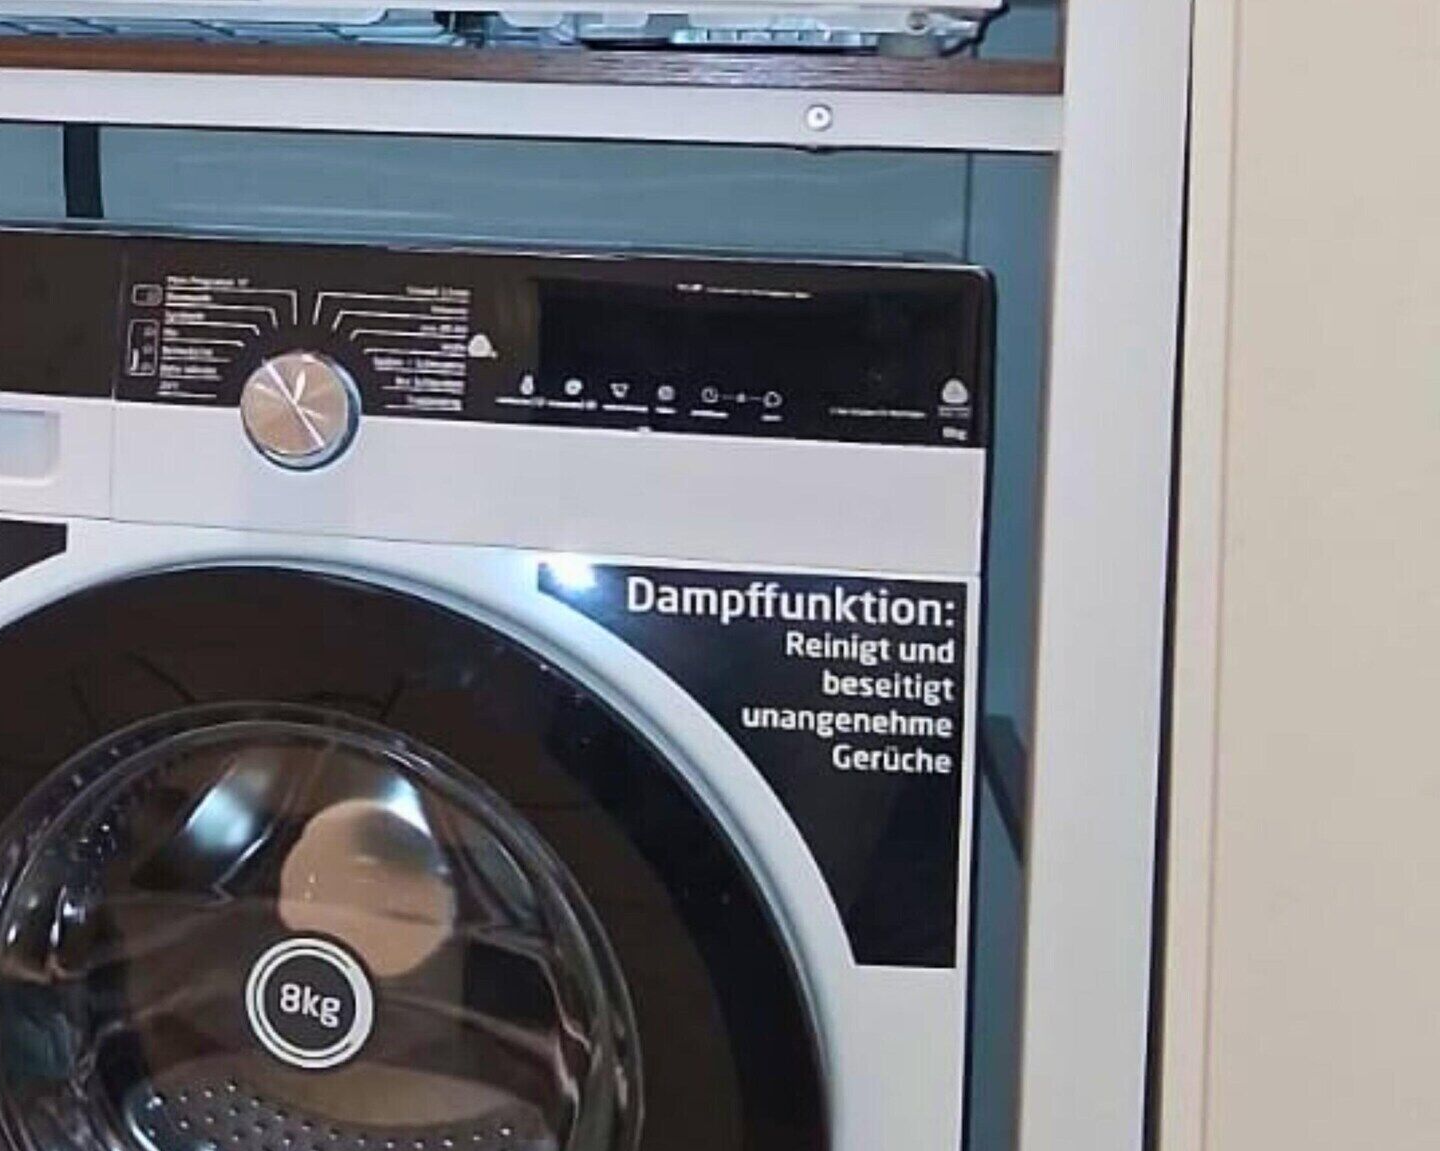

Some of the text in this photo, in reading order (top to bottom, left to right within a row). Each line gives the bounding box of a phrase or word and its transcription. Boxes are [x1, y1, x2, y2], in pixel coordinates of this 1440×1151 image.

[626, 576, 956, 627] Dampffunktion:
[785, 632, 955, 665] Reinigt und
[822, 671, 955, 706] beseitigt
[742, 705, 953, 739] unangenehme
[832, 744, 953, 774] Gerüche
[280, 983, 341, 1028] 8kg
